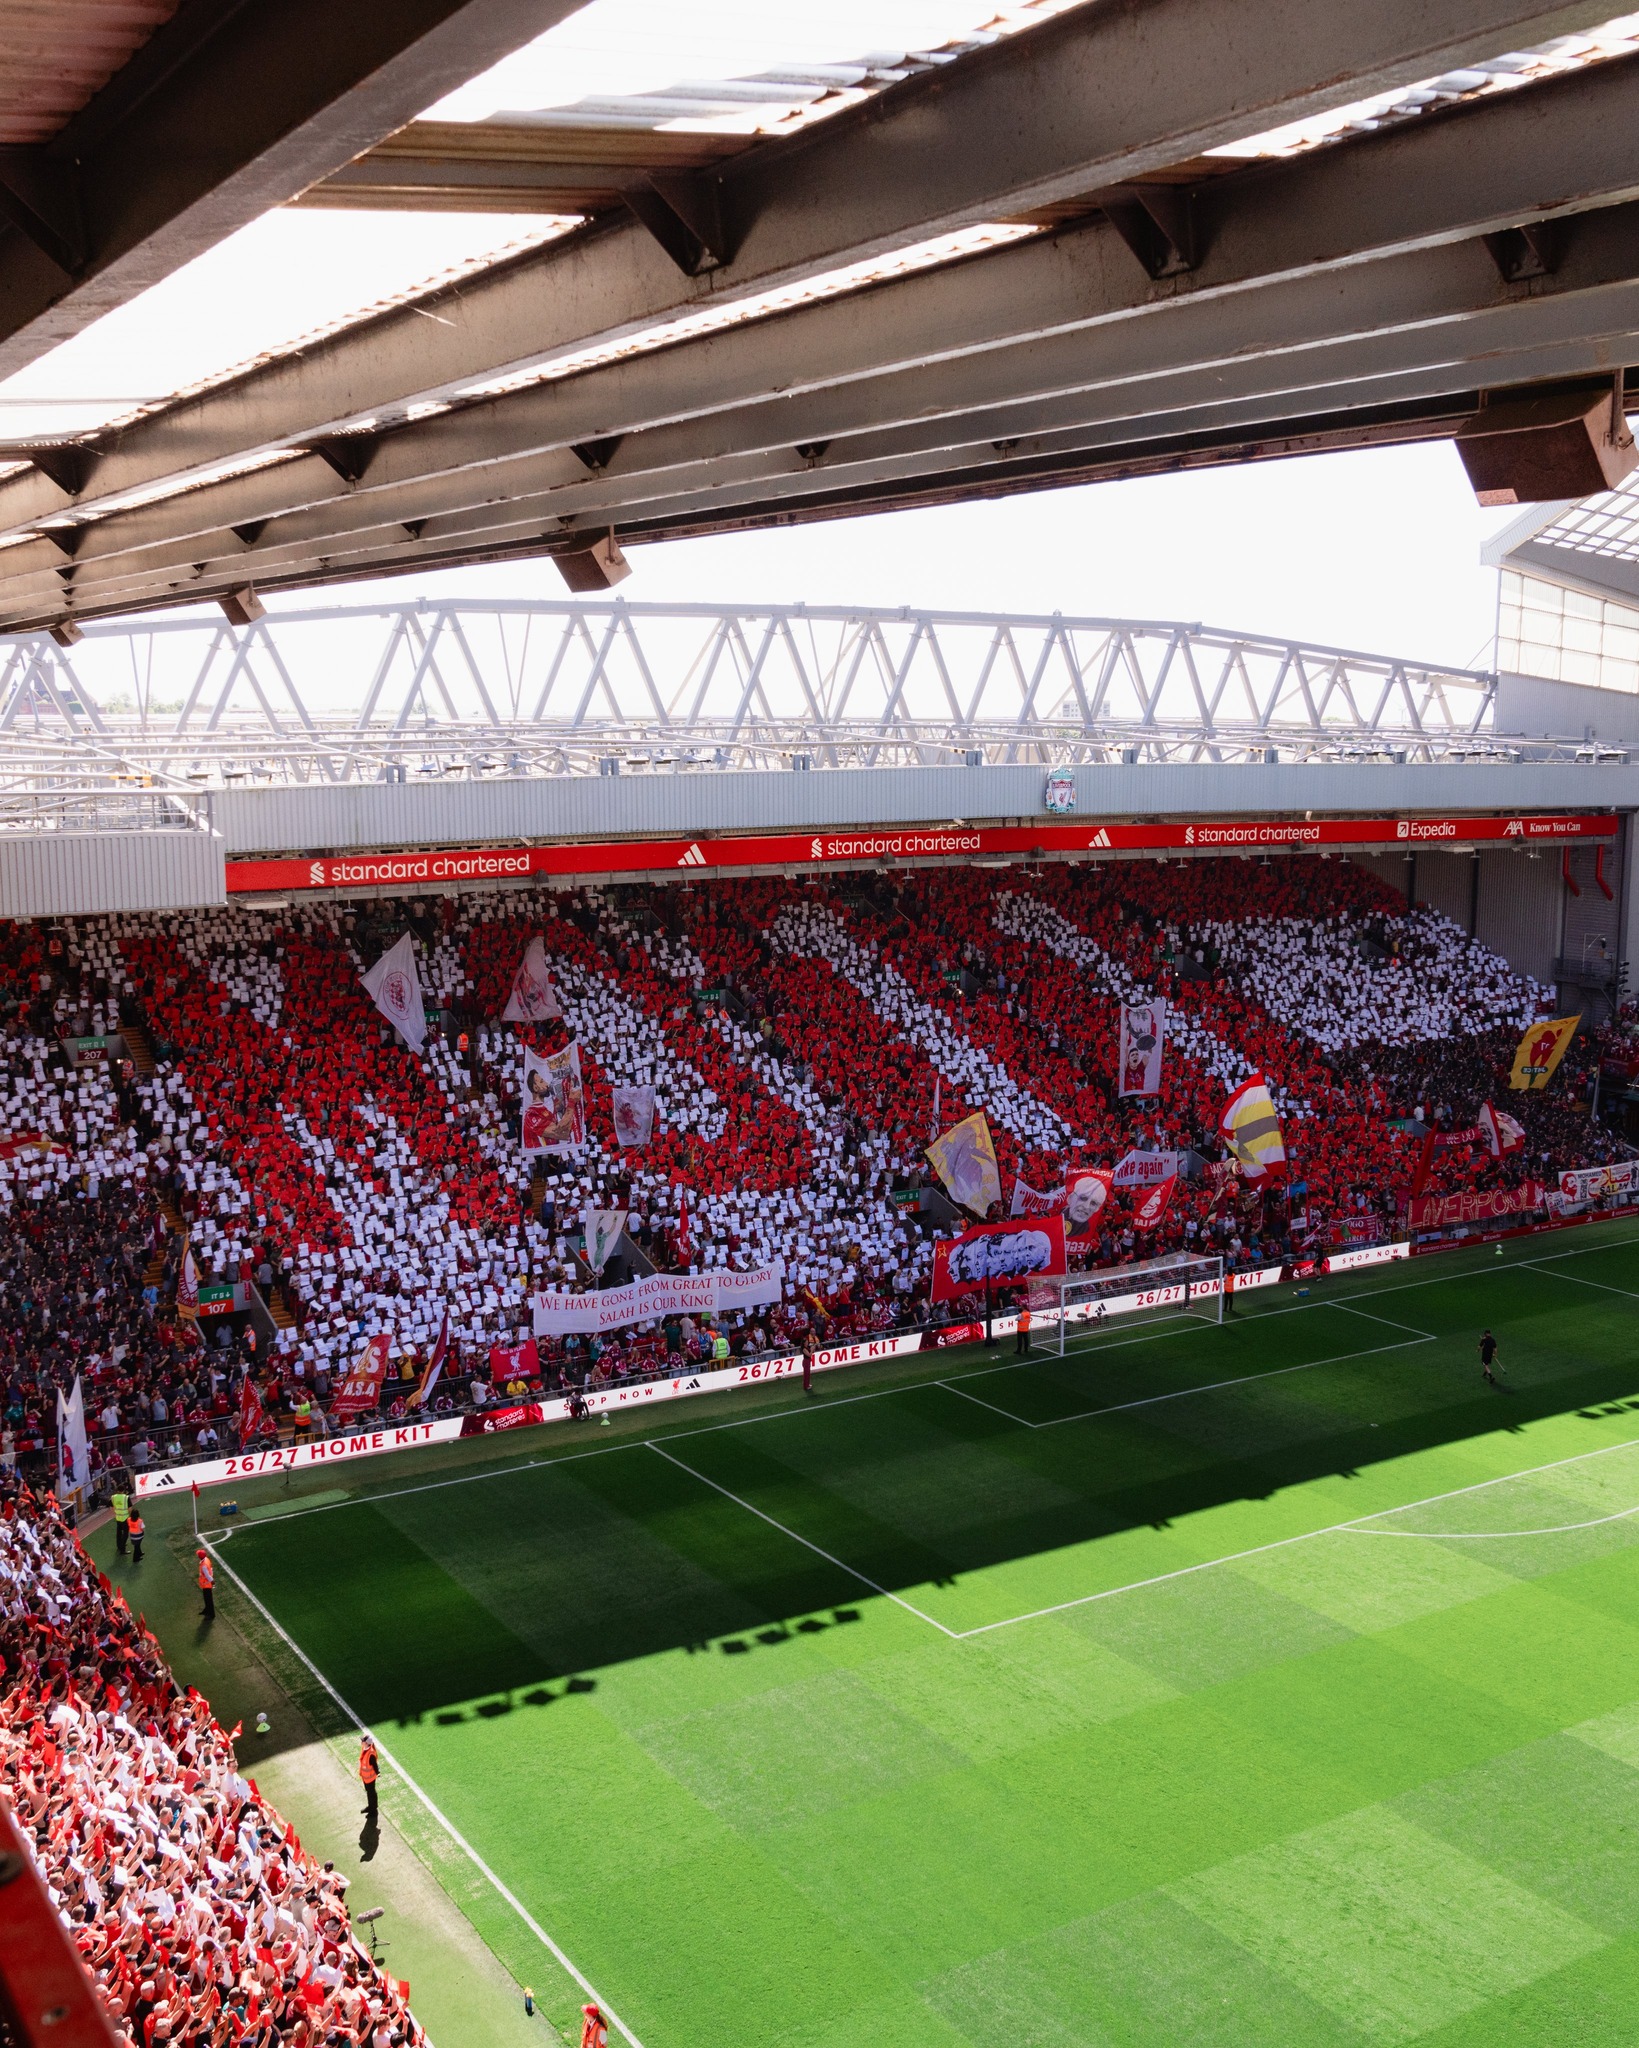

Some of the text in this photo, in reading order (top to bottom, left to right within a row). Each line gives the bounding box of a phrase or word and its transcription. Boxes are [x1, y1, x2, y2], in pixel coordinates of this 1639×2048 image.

[1198, 826, 1320, 842] standard chartered
[1411, 822, 1456, 838] Expedia
[1503, 821, 1581, 835] AXA Know You Can
[828, 834, 981, 855] standard chartered
[331, 853, 530, 881] standard chartered
[84, 1051, 102, 1060] 207
[1408, 1182, 1536, 1229] LIVERPOOL
[1342, 1247, 1400, 1265] SHOP NOW
[540, 1269, 772, 1311] WE HAVE GONE FROM GREAT TO GLORY
[1137, 1272, 1264, 1306] 26/27 HOM KIT
[208, 1303, 226, 1314] 107
[600, 1294, 713, 1326] SALAH IS OUR KING
[1043, 1310, 1070, 1321] NOW
[738, 1357, 795, 1382] 26/27
[869, 1338, 900, 1357] KIT
[563, 1388, 653, 1411] SOP NOW
[225, 1424, 434, 1475] 26/27 HOME KIT
